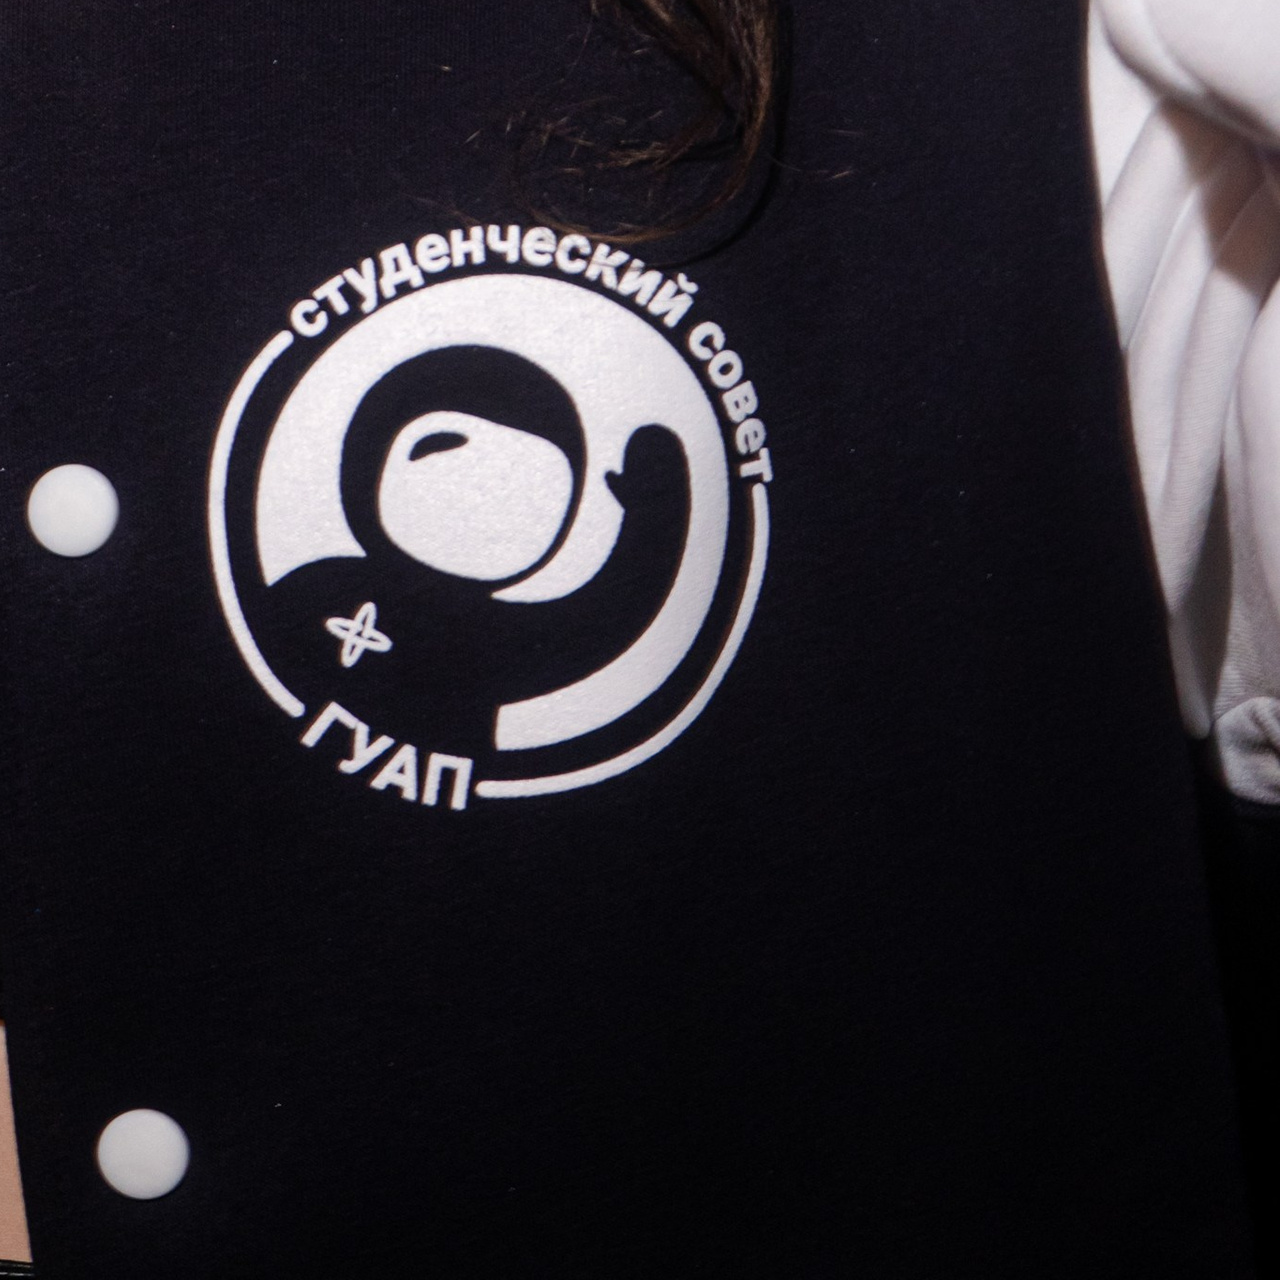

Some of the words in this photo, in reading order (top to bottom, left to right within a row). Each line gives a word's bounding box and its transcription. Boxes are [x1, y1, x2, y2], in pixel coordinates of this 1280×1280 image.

[290, 224, 700, 339] студенческий
[688, 321, 773, 483] совет
[301, 702, 473, 811] ГУАП
